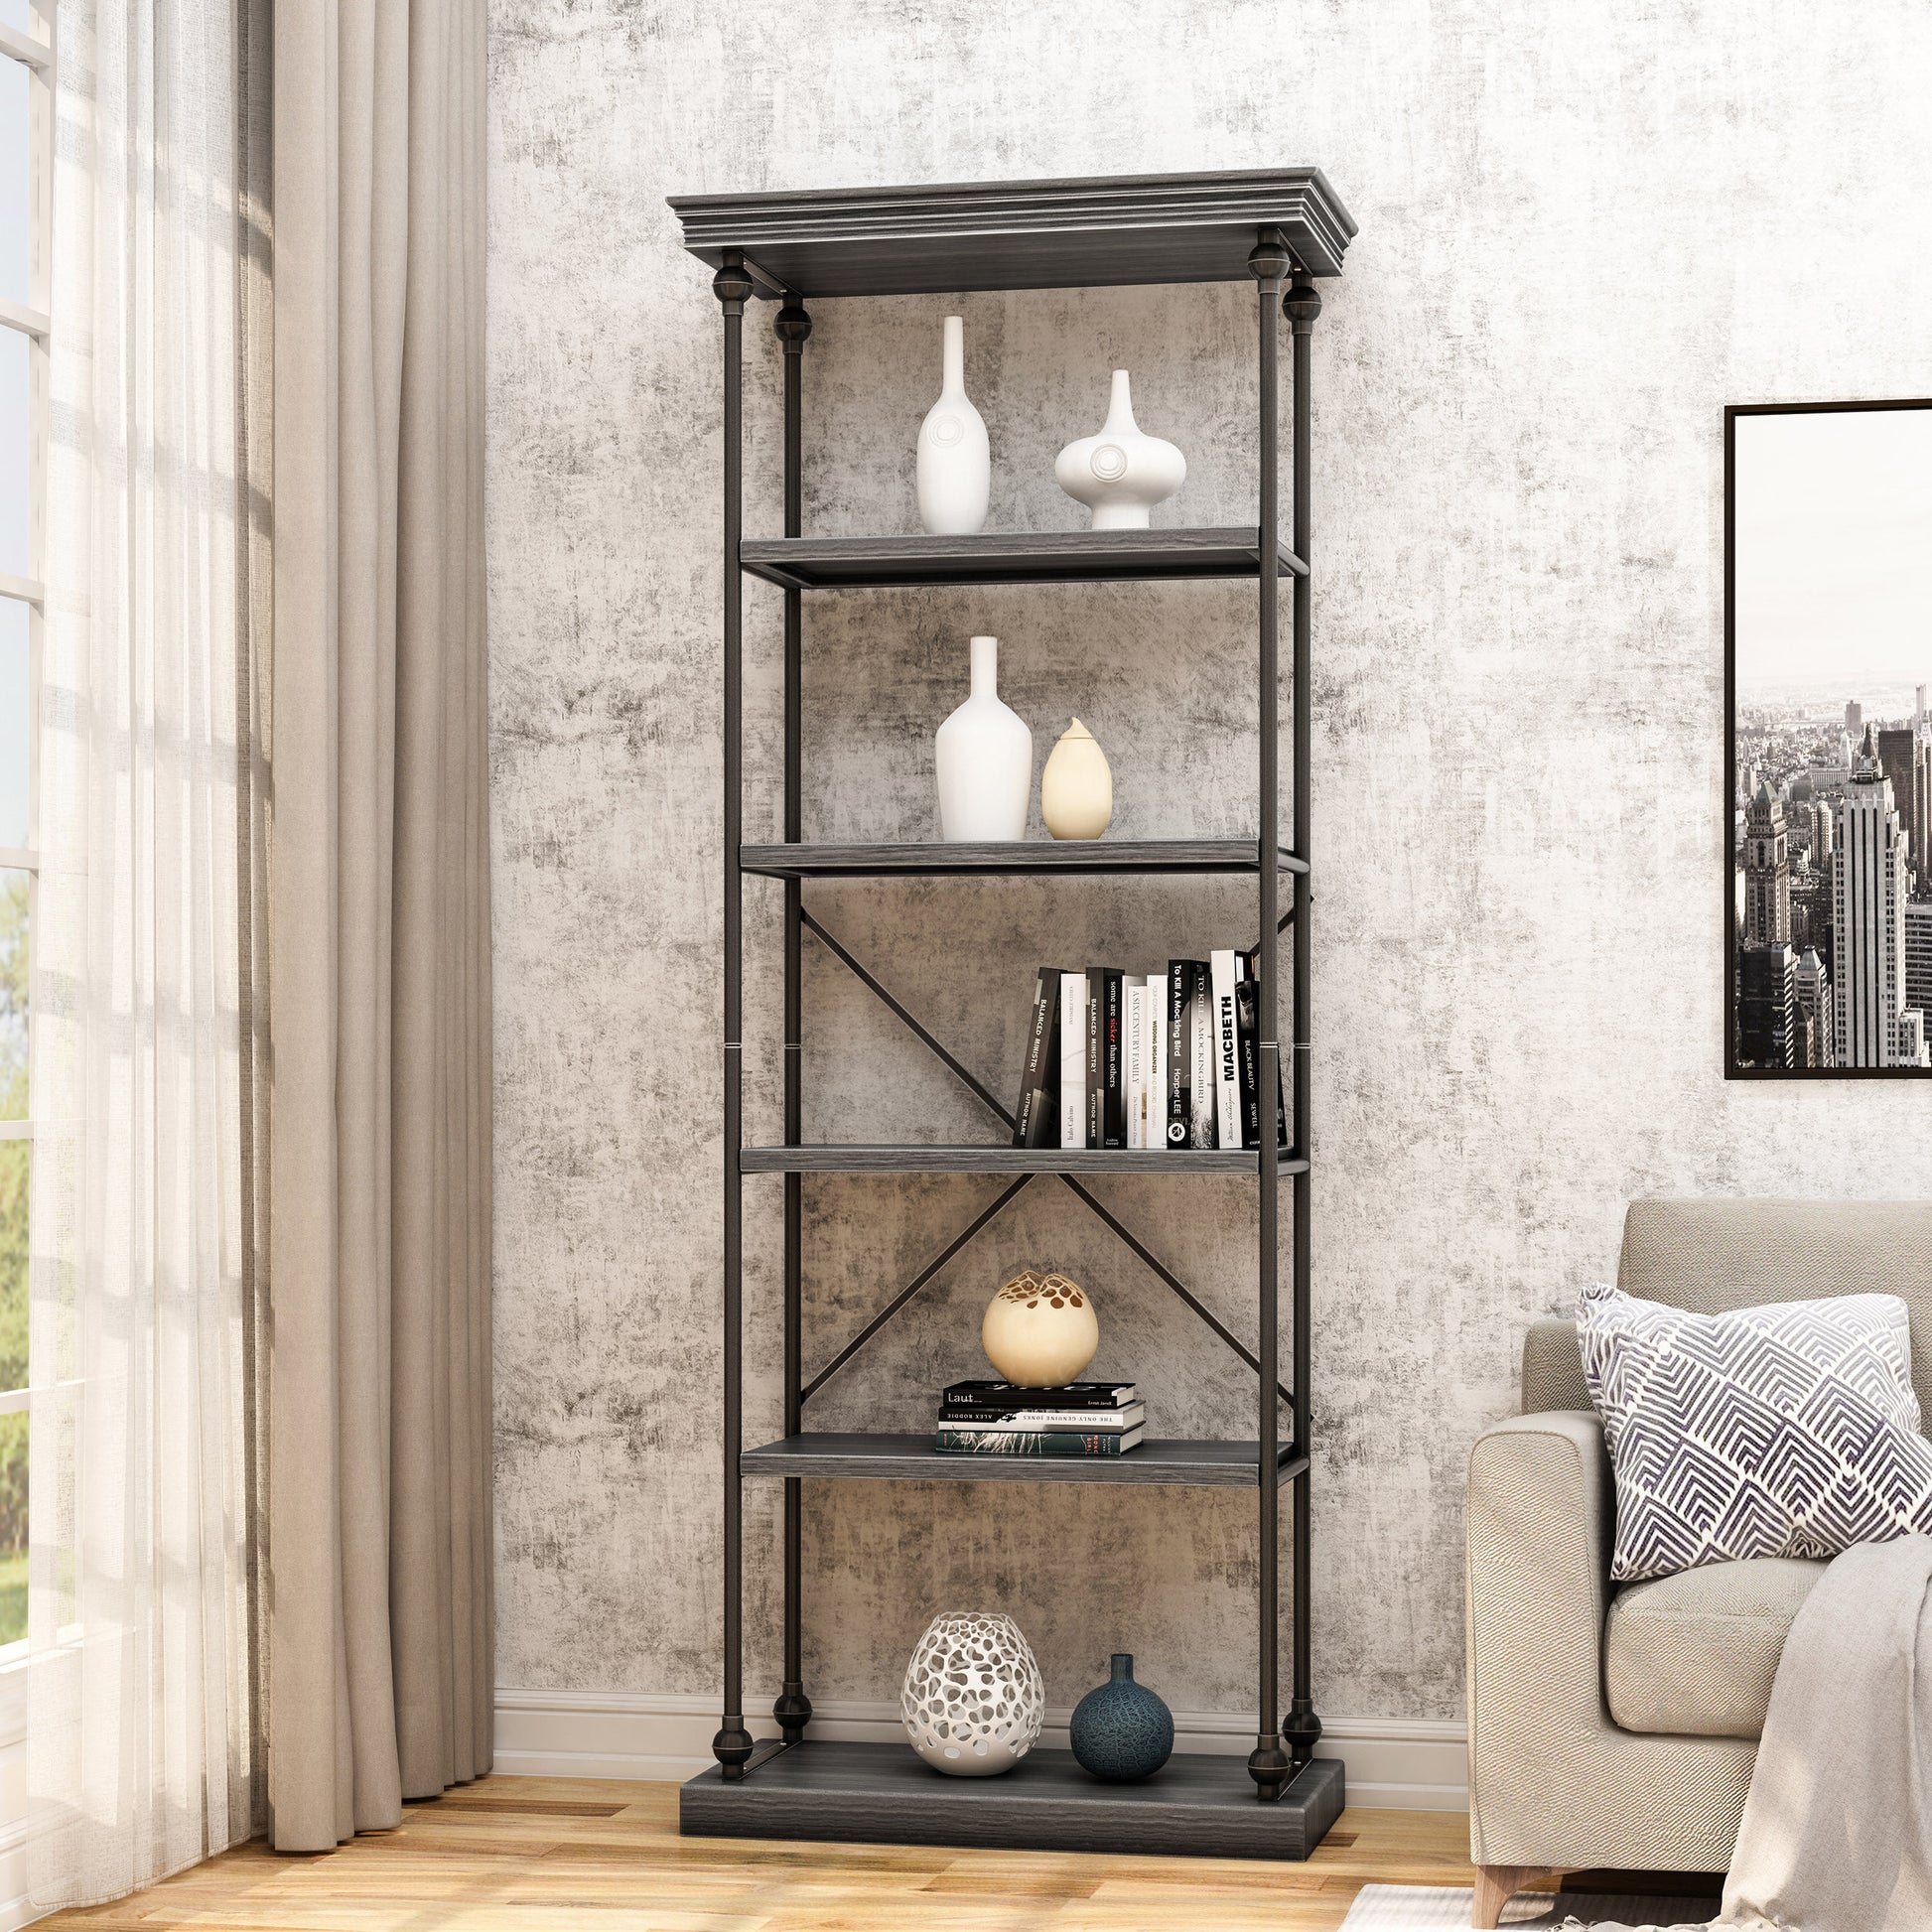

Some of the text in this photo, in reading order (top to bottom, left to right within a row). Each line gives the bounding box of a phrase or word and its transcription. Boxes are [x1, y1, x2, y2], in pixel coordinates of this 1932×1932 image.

[1173, 965, 1181, 975] To
[1197, 975, 1204, 991] TO
[1035, 999, 1047, 1035] BALANCED
[1172, 1001, 1181, 1038] Mocking
[1221, 996, 1234, 1081] MACBETH
[1029, 1037, 1039, 1072] MINISTRY
[1172, 1068, 1181, 1098] Harper
[1246, 1062, 1255, 1091] BEAUTY
[1023, 1092, 1032, 1117] AUTHOR
[948, 1392, 974, 1403] Laut
